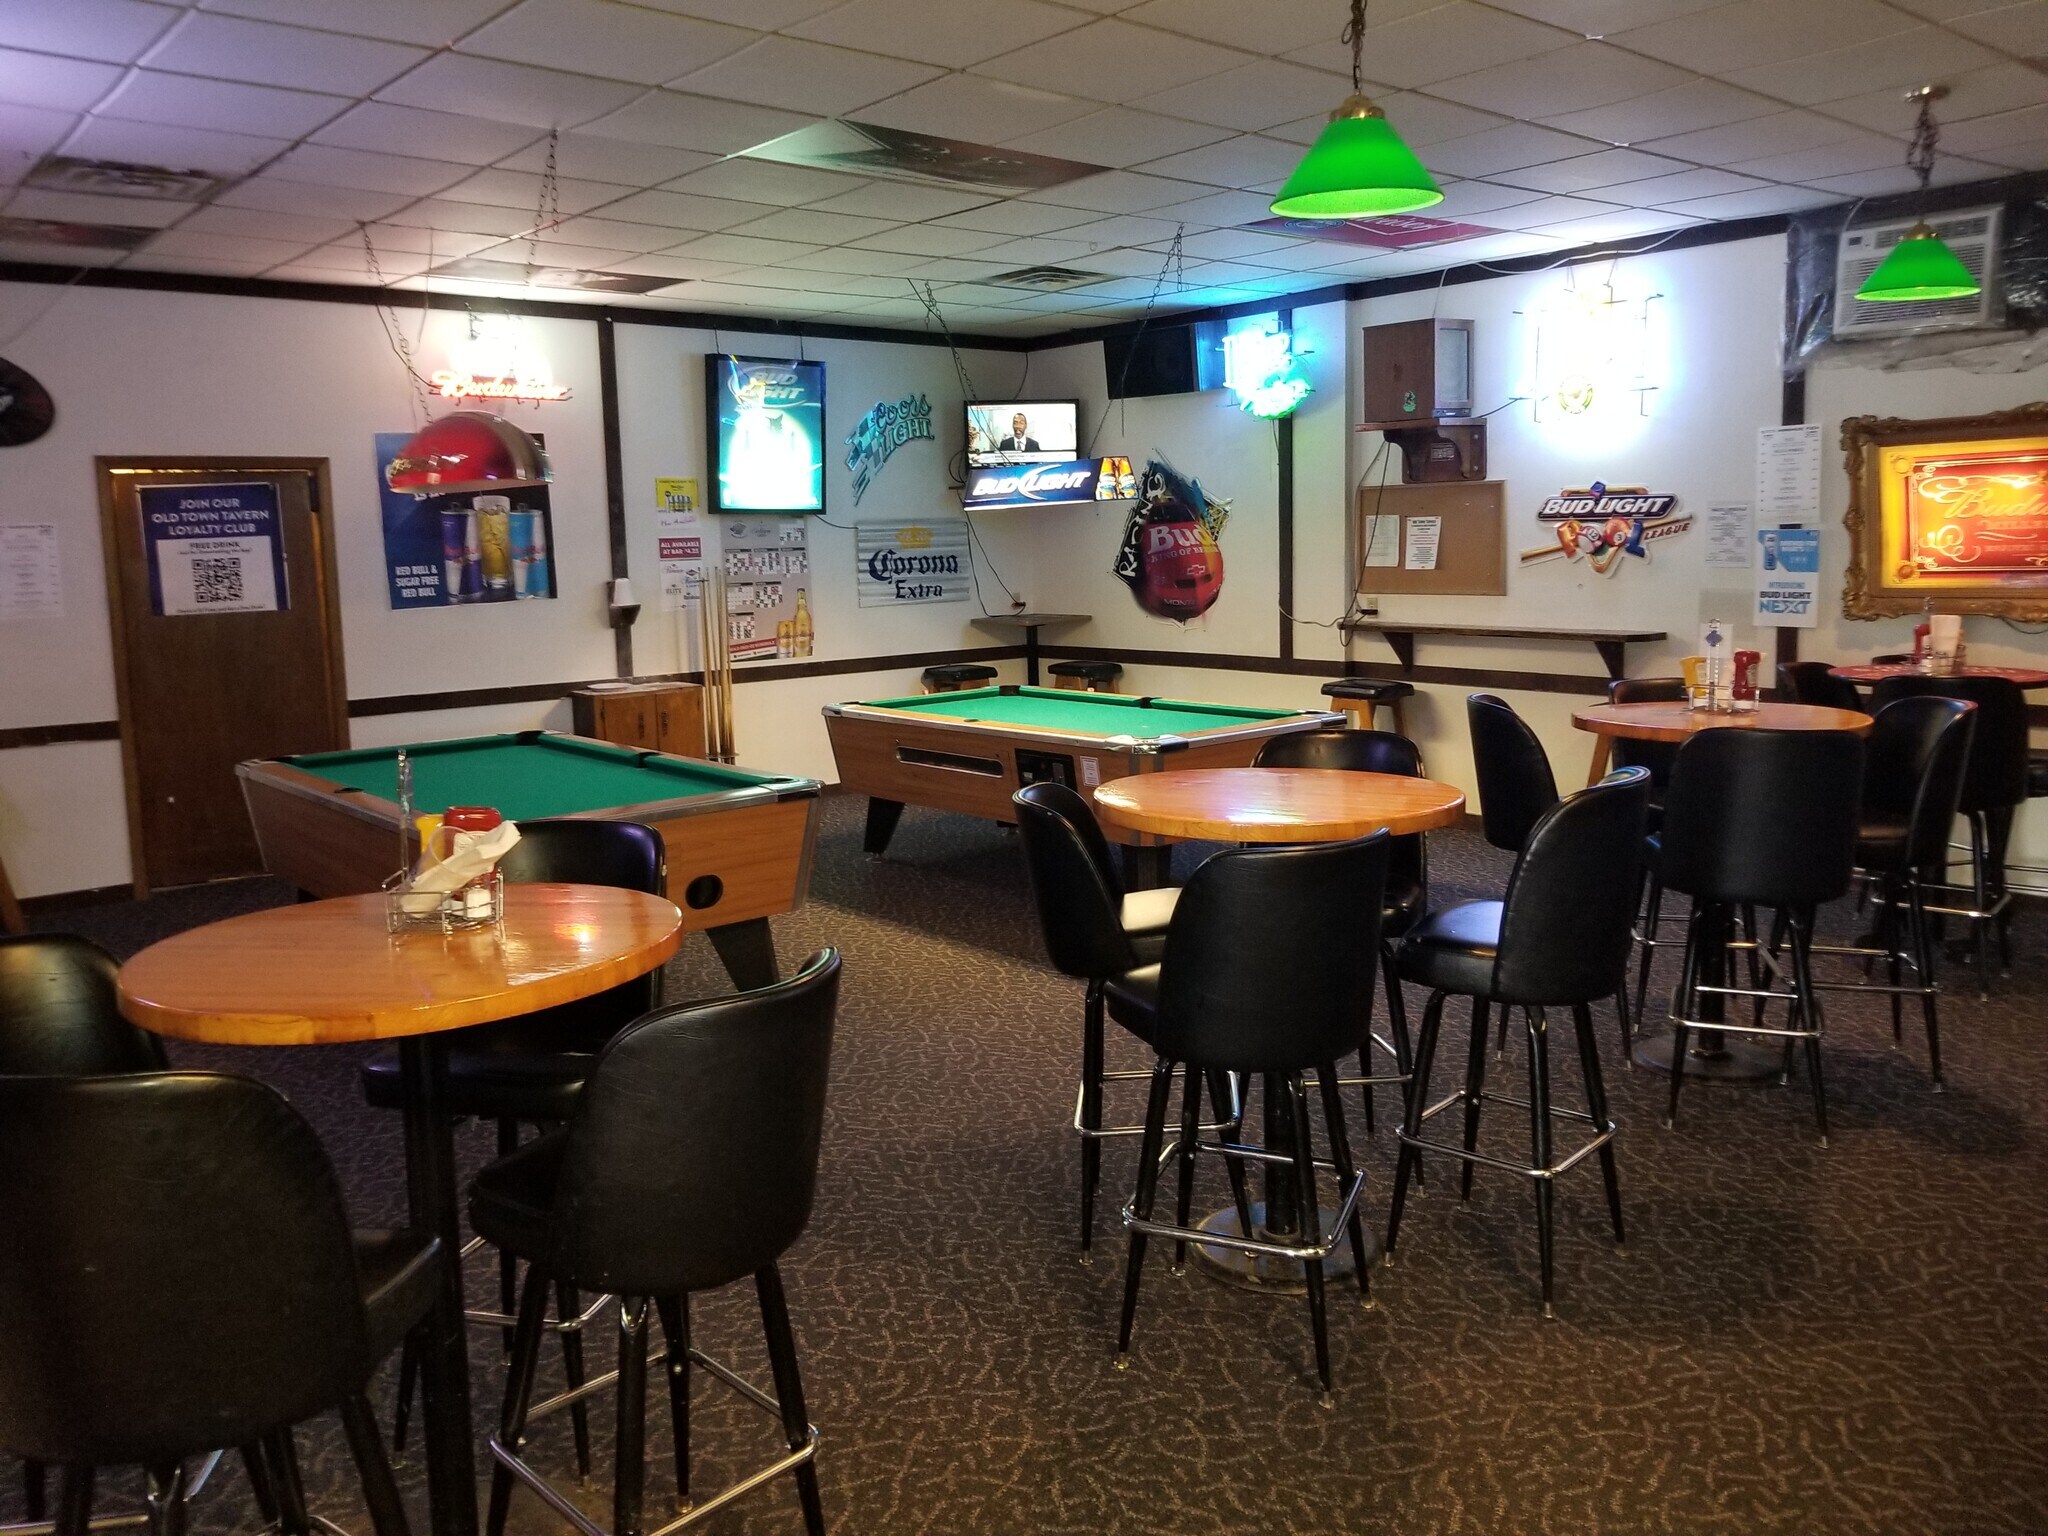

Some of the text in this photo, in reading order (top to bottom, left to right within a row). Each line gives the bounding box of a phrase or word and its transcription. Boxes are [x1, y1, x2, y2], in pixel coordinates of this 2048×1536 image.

[875, 393, 933, 430] Coors
[879, 416, 936, 464] LIGHT
[972, 471, 1092, 496] BUD LIGHT
[180, 498, 240, 509] JOIN OUR
[1542, 496, 1670, 516] BUD LIGHT
[151, 510, 269, 523] OLD TOWN TAVERN
[168, 523, 257, 535] LOYALTY CLUB
[1643, 522, 1690, 540] LEAGUE
[1147, 523, 1216, 555] Bud
[1179, 548, 1192, 556] OF
[395, 566, 411, 576] RED
[412, 566, 429, 575] BULL
[868, 548, 959, 585] Corona
[395, 576, 440, 587] SUGAR FREE
[895, 579, 943, 599] Extra
[402, 587, 437, 597] RED BULL
[1760, 591, 1812, 599] BUD LIGHT
[1760, 599, 1813, 614] NEXT
